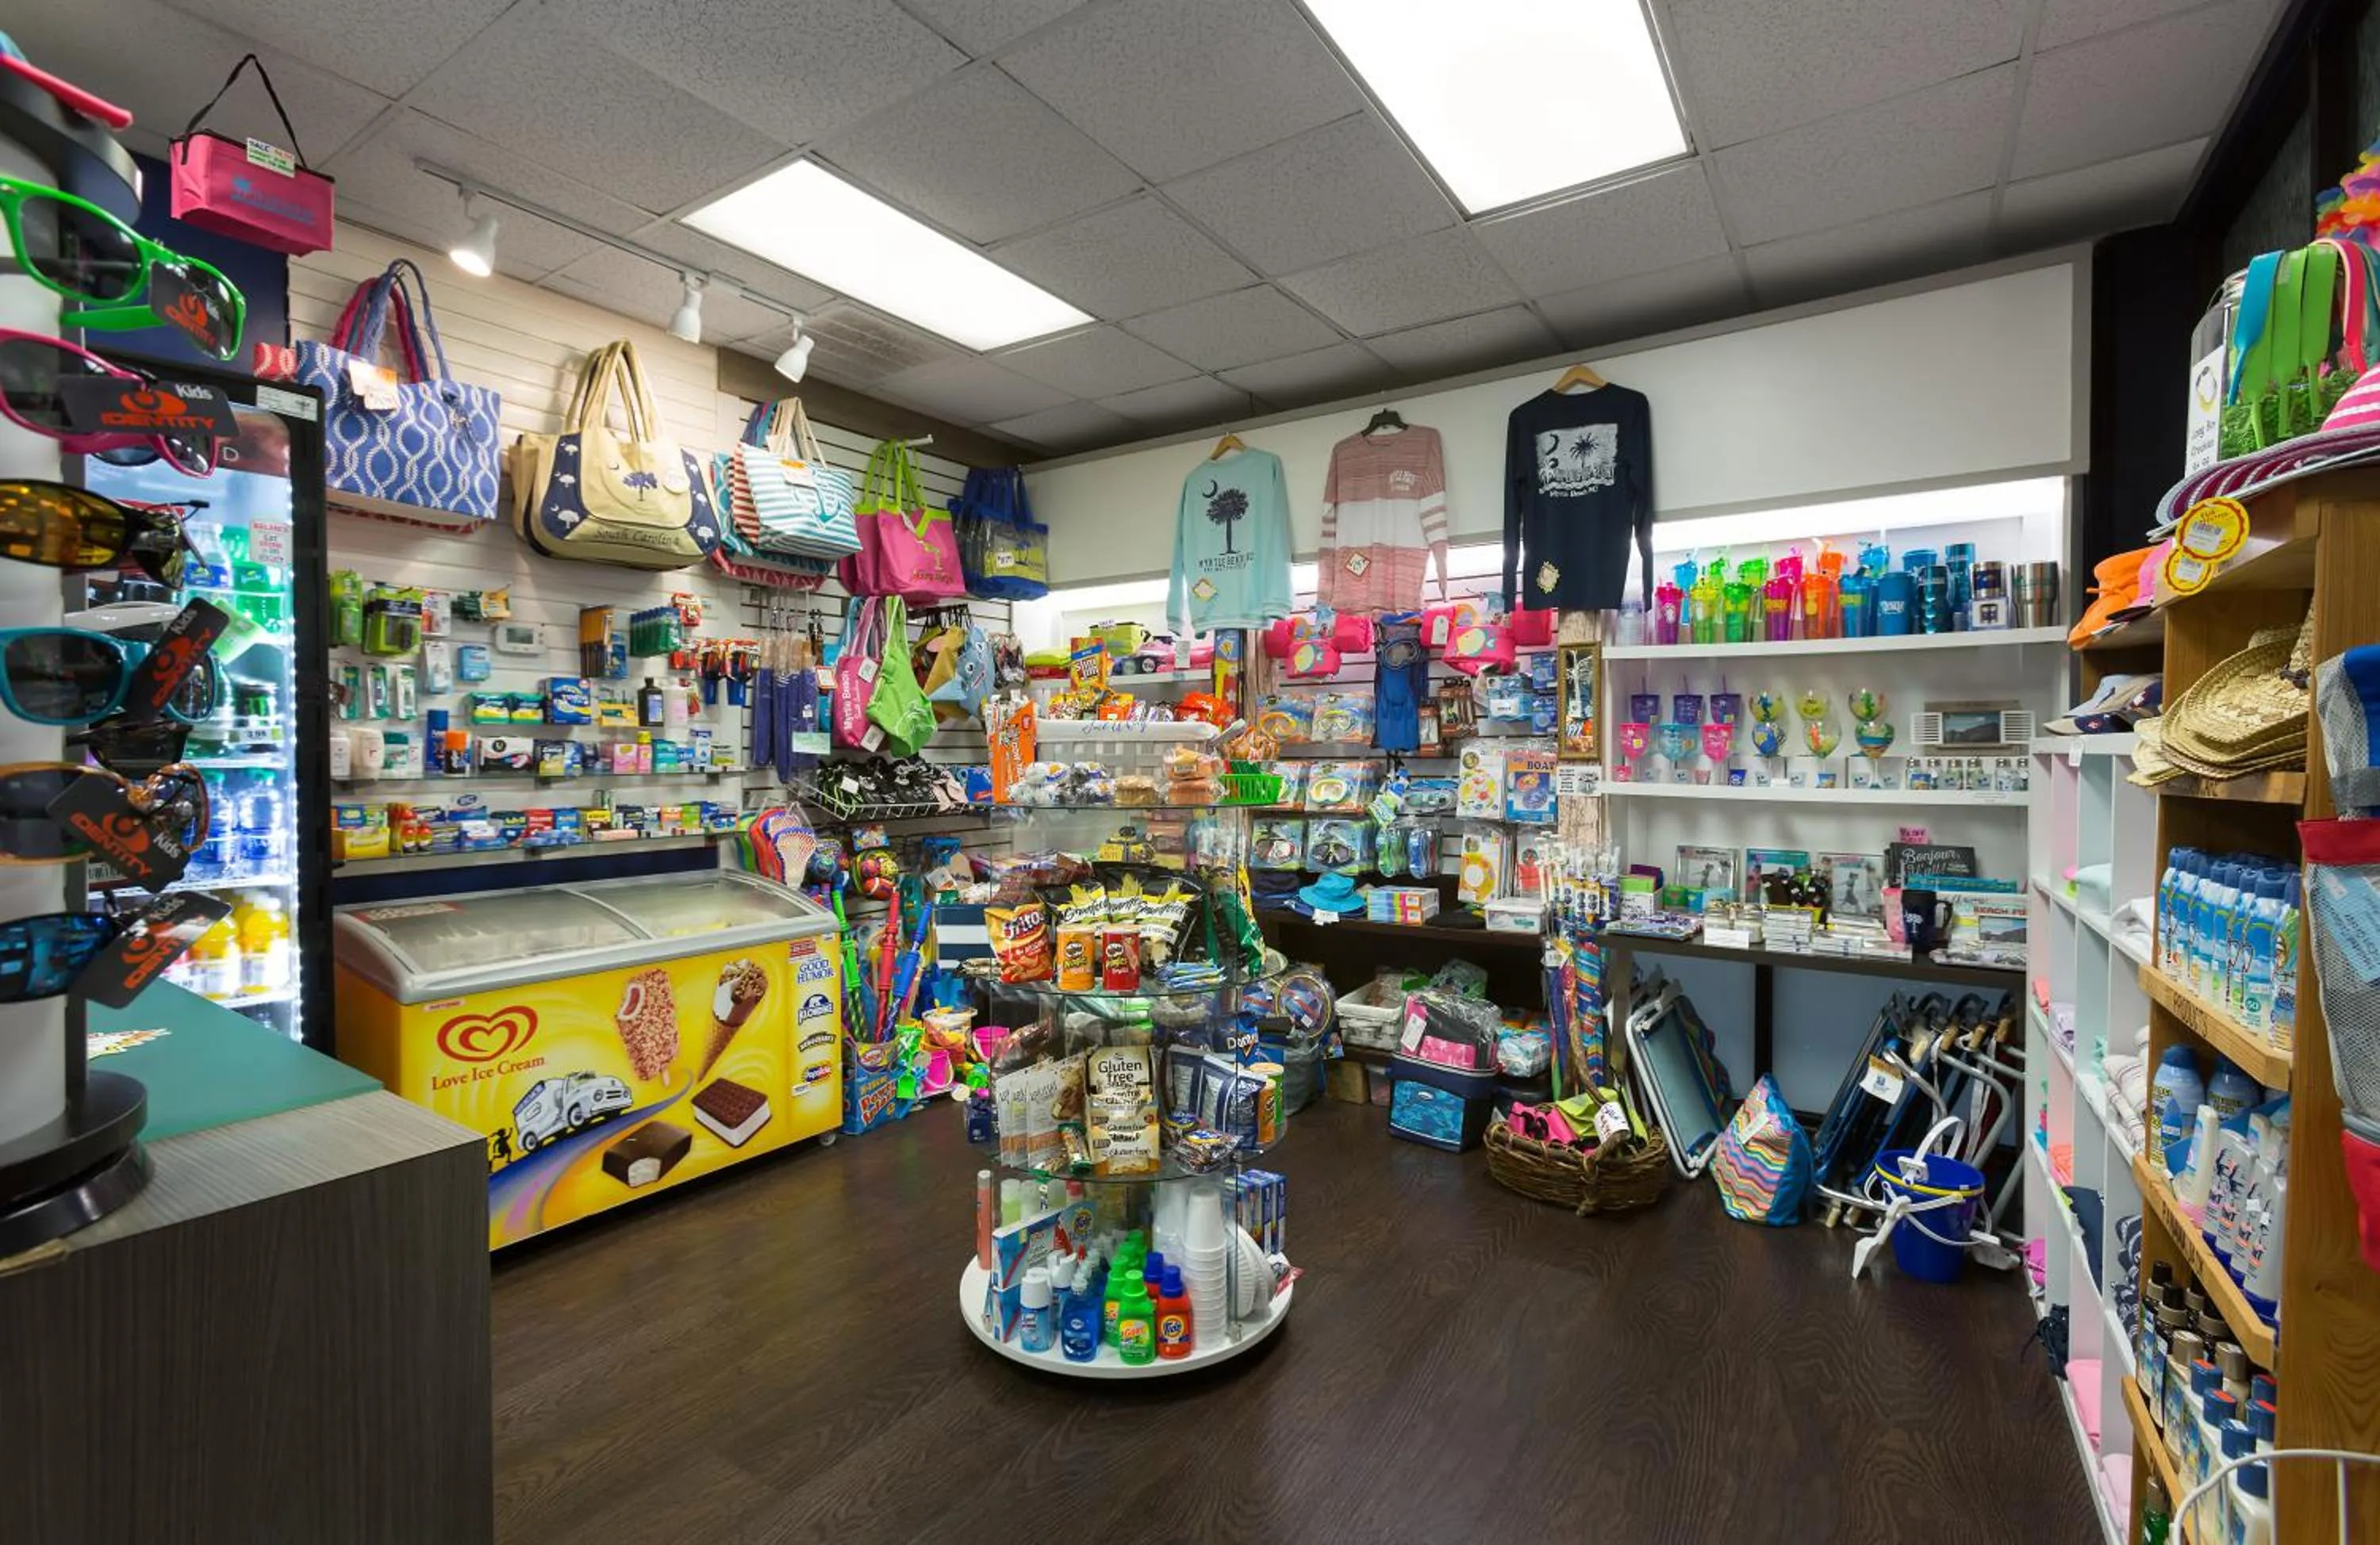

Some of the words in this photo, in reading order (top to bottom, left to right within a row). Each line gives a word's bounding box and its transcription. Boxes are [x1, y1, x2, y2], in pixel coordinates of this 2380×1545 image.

[175, 384, 213, 400] Kids
[100, 411, 215, 431] IDENTITY
[69, 811, 153, 879] IDENTITY
[152, 831, 182, 859] Kids
[799, 958, 830, 972] GOOD
[797, 970, 835, 985] HUMOR
[432, 1075, 468, 1091] Love
[472, 1067, 494, 1081] Ice
[497, 1056, 545, 1075] Cream
[1098, 1060, 1143, 1073] Gluten
[1107, 1071, 1134, 1084] free
